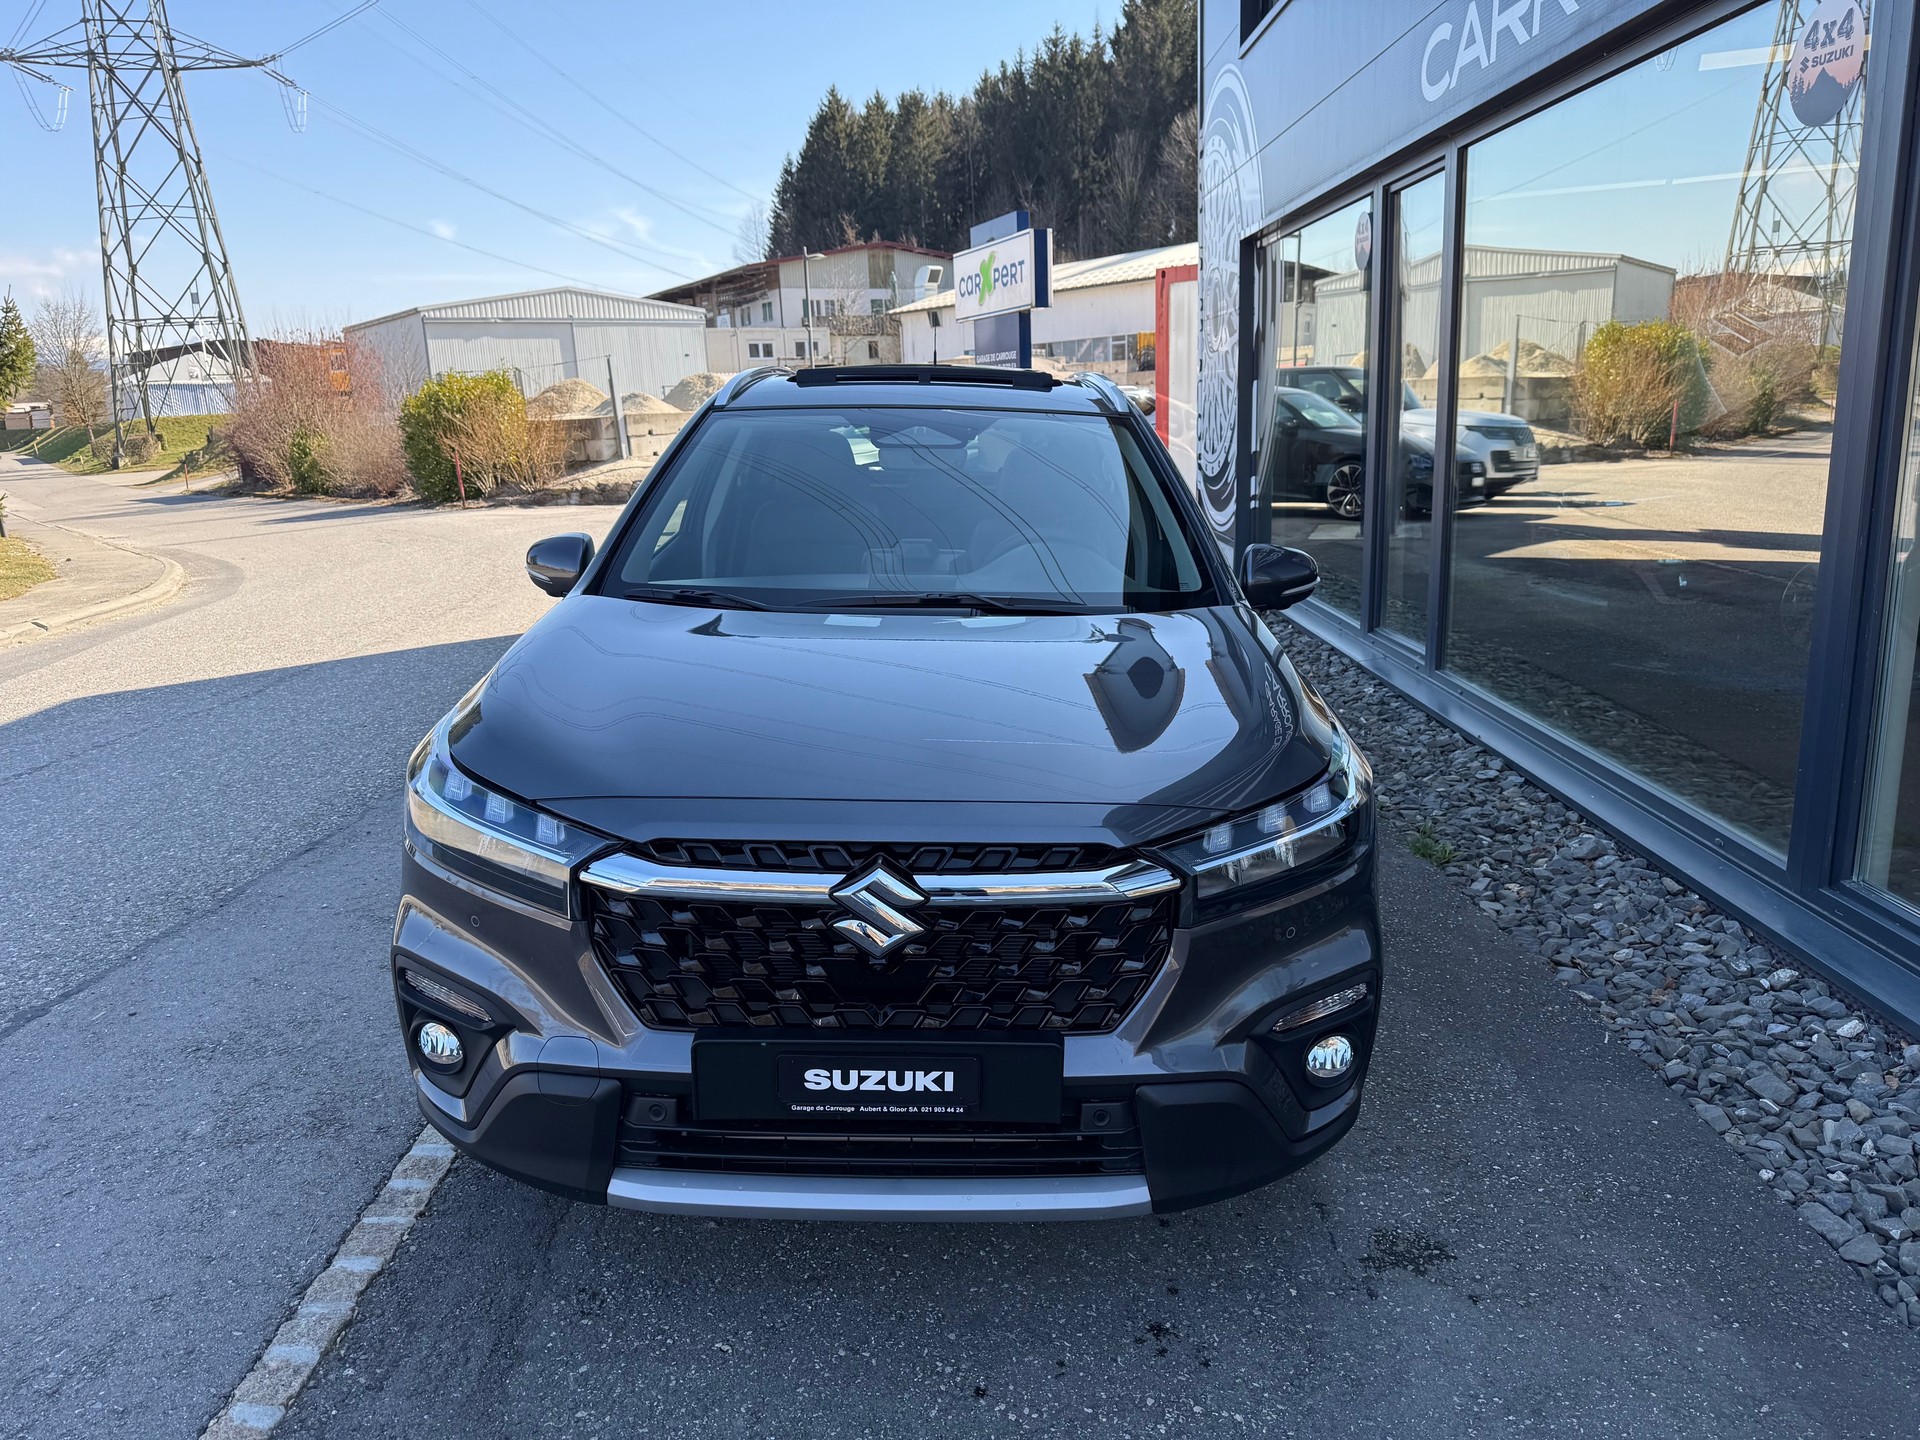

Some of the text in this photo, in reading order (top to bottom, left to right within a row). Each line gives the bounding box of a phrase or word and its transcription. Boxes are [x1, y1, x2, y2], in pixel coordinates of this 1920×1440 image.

[1811, 44, 1855, 69] SUZUKI
[976, 354, 991, 364] GARAGE
[990, 353, 997, 362] DE
[803, 1068, 955, 1092] SUZUKI
[791, 1104, 815, 1112] Garage
[825, 1105, 855, 1113] Carrouge
